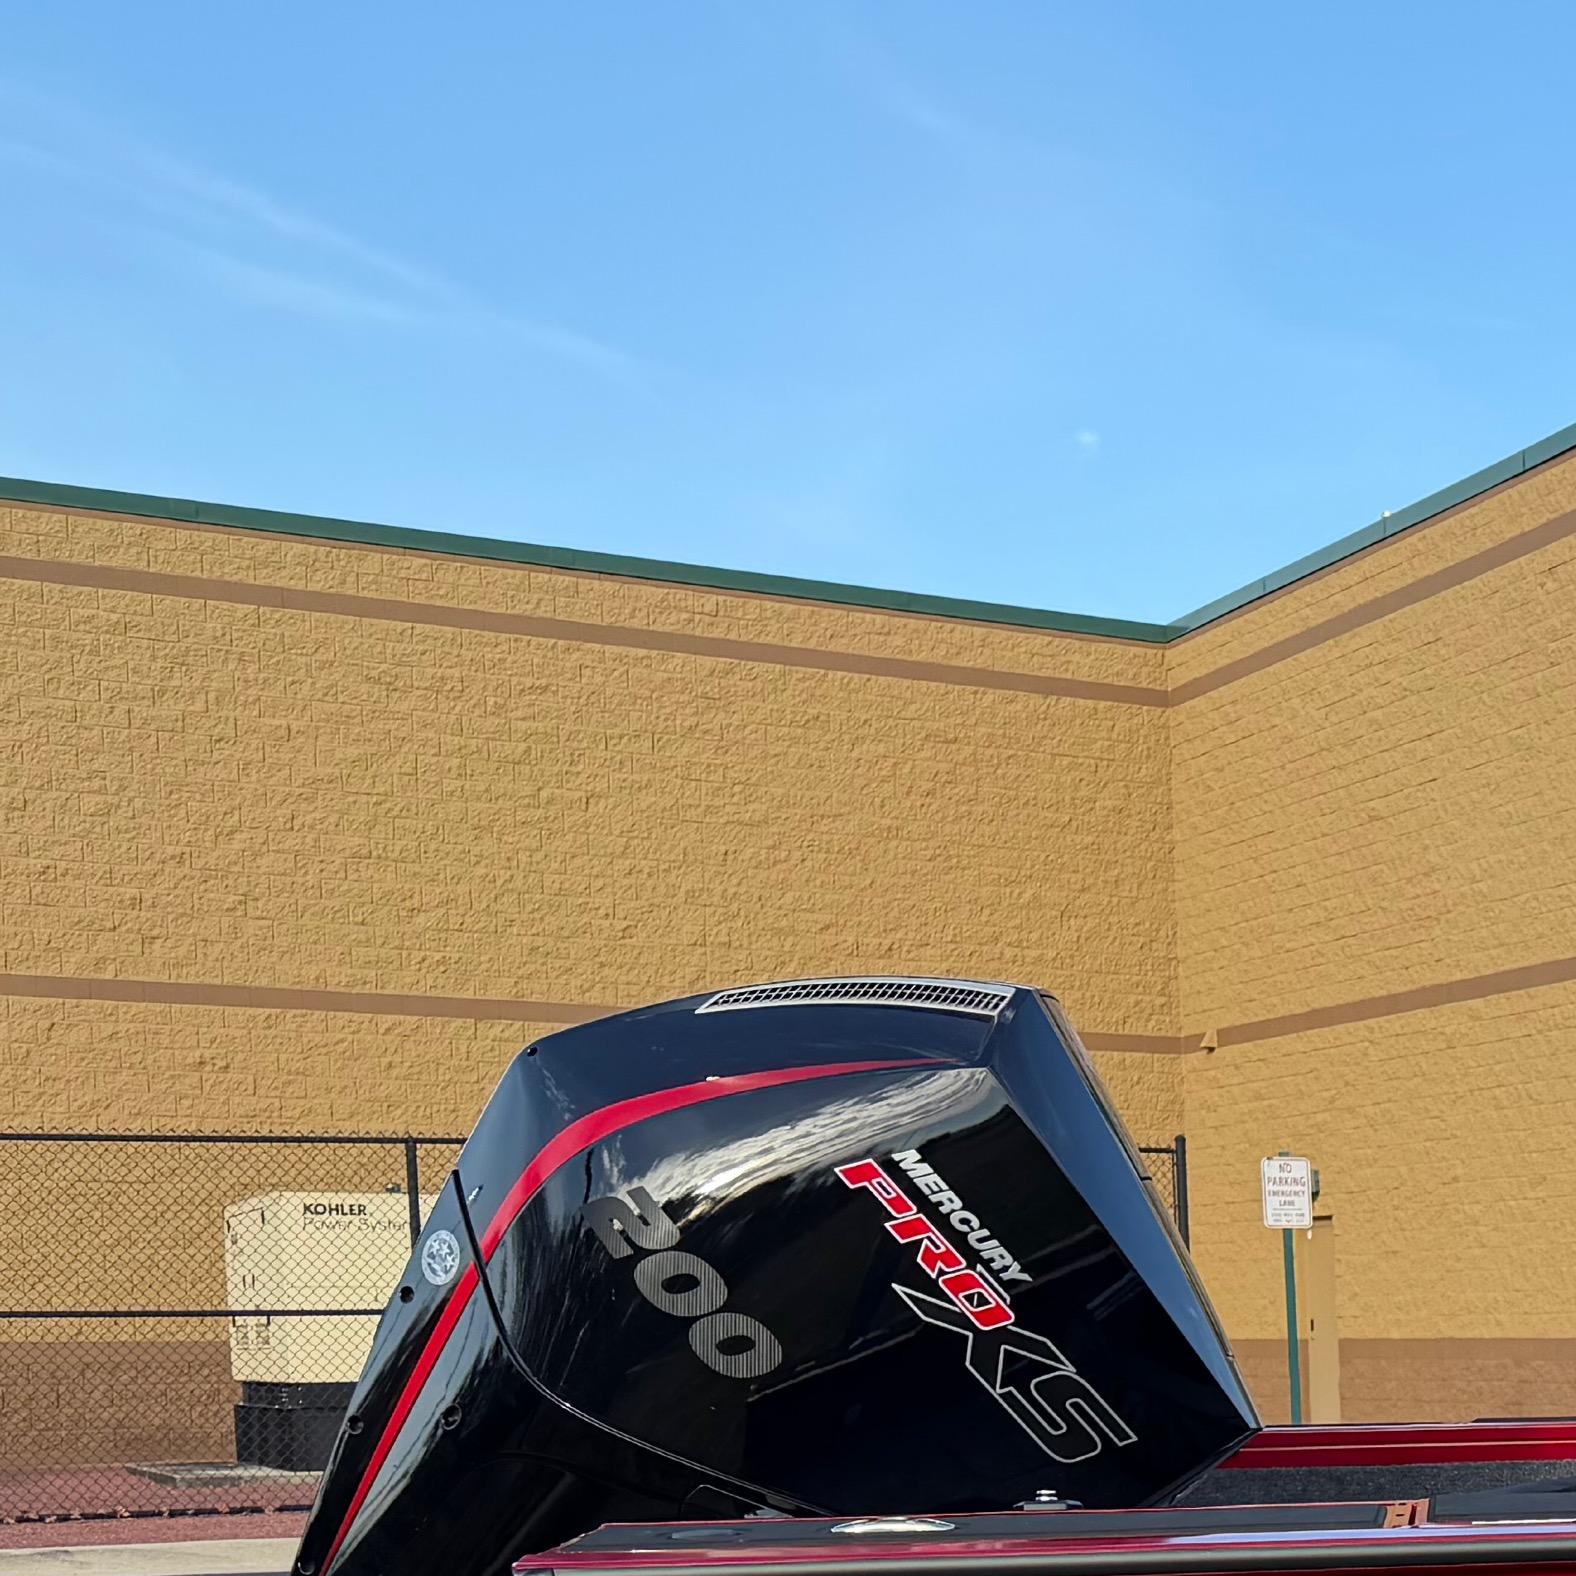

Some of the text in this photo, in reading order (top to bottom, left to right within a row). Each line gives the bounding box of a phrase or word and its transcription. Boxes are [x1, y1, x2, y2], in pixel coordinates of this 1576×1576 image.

[1279, 1163, 1293, 1174] NO
[1267, 1176, 1306, 1187] PARKING
[1268, 1189, 1305, 1198] EMERGENCY
[303, 1203, 368, 1216] KOHLER
[891, 1149, 1033, 1285] MERCURY
[303, 1217, 354, 1232] Power
[582, 1185, 783, 1379] 200
[834, 1158, 1139, 1463] PRO XS
